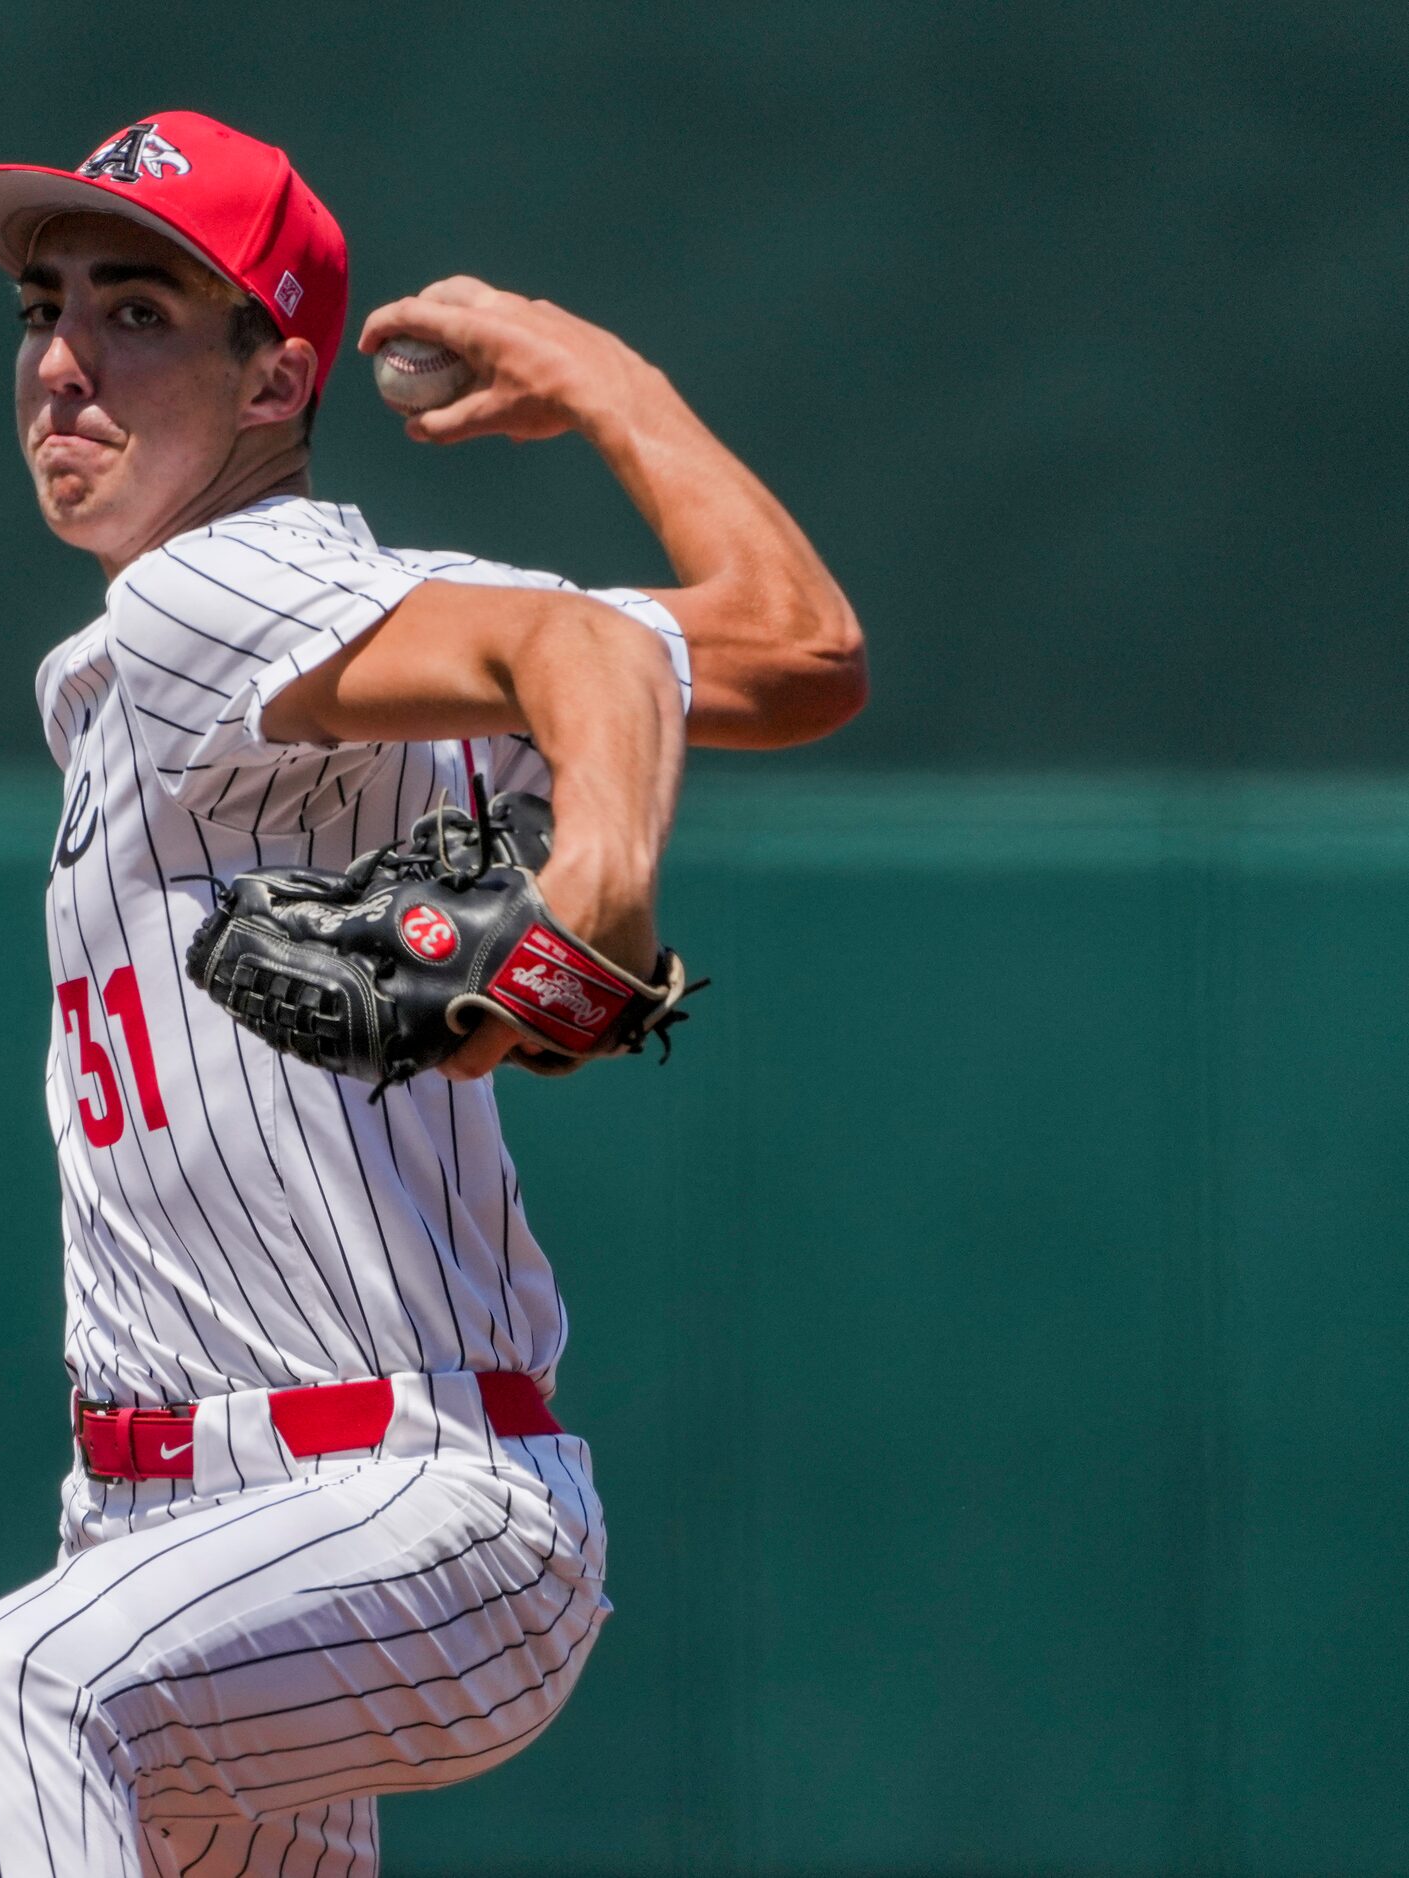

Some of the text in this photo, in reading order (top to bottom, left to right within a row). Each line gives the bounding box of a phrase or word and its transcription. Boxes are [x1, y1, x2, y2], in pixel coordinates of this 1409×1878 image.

[81, 124, 155, 182] A
[404, 906, 451, 954] 32
[512, 964, 607, 1026] Rawlings
[57, 965, 169, 1148] 31
